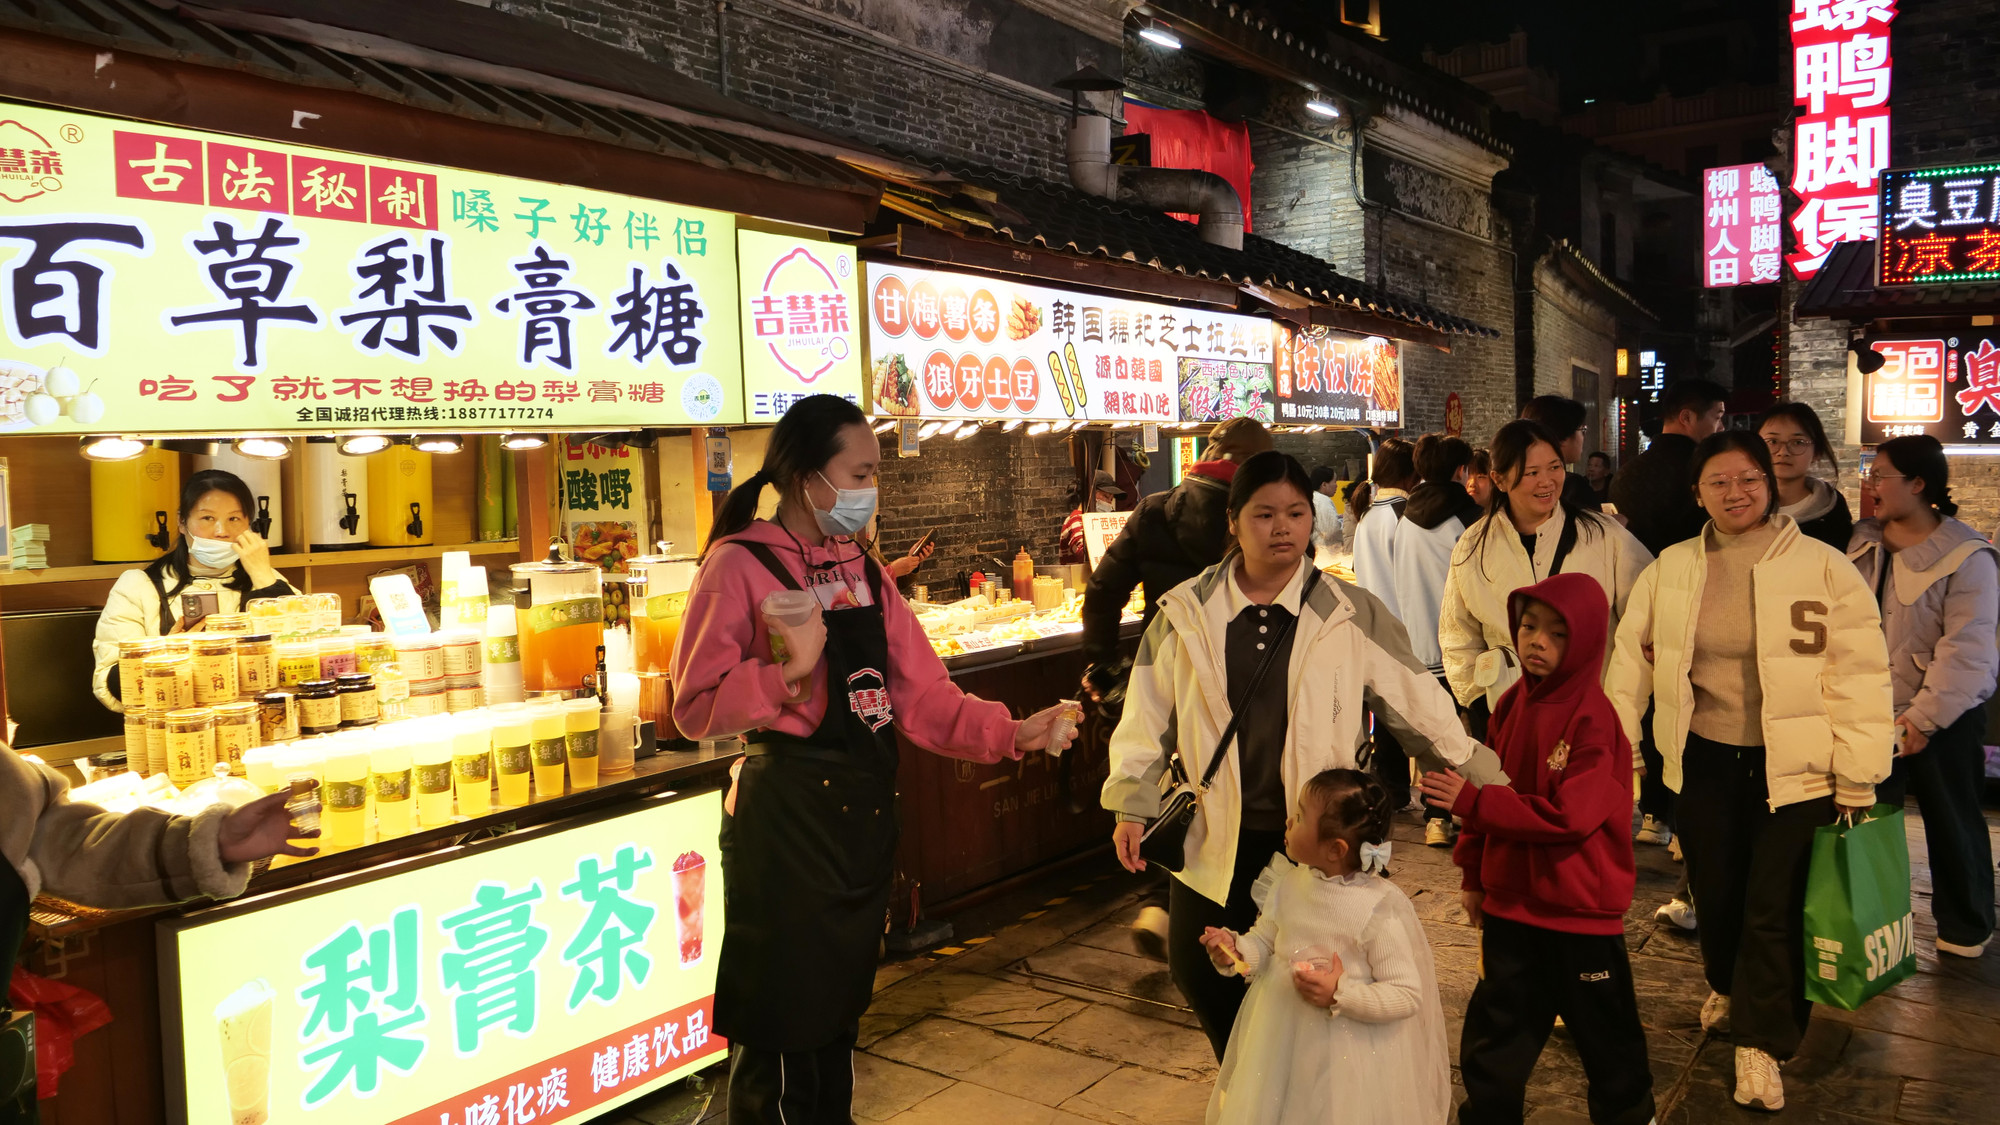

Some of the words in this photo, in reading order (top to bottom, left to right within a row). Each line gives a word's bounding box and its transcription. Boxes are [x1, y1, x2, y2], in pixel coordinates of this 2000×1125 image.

[128, 141, 430, 226] 古法秘制
[1893, 176, 2000, 231] 臭豆
[452, 188, 708, 257] 嗓子好伴侣
[1707, 168, 1740, 286] 柳州人田
[1749, 165, 1781, 282] 螺鸭脚煲
[0, 219, 704, 368] 百草梨膏糖
[752, 294, 849, 336] 吉慧莱
[877, 286, 997, 333] 甘梅薯条
[787, 337, 824, 347] JIHUILAI
[1294, 333, 1374, 397] 铁板烧
[138, 374, 666, 405] 吃了就不想换的梨膏糖
[927, 361, 1037, 399] 狼牙土豆
[1187, 361, 1265, 380] 广西特色小吃
[296, 405, 554, 422] 全国诚招代理热线:18877177274
[1103, 391, 1171, 417] 網紅小吃
[567, 468, 633, 511] 酸嘢
[1789, 600, 1829, 655] S
[301, 845, 655, 1106] 梨膏茶
[590, 1008, 709, 1094] 健康饮品
